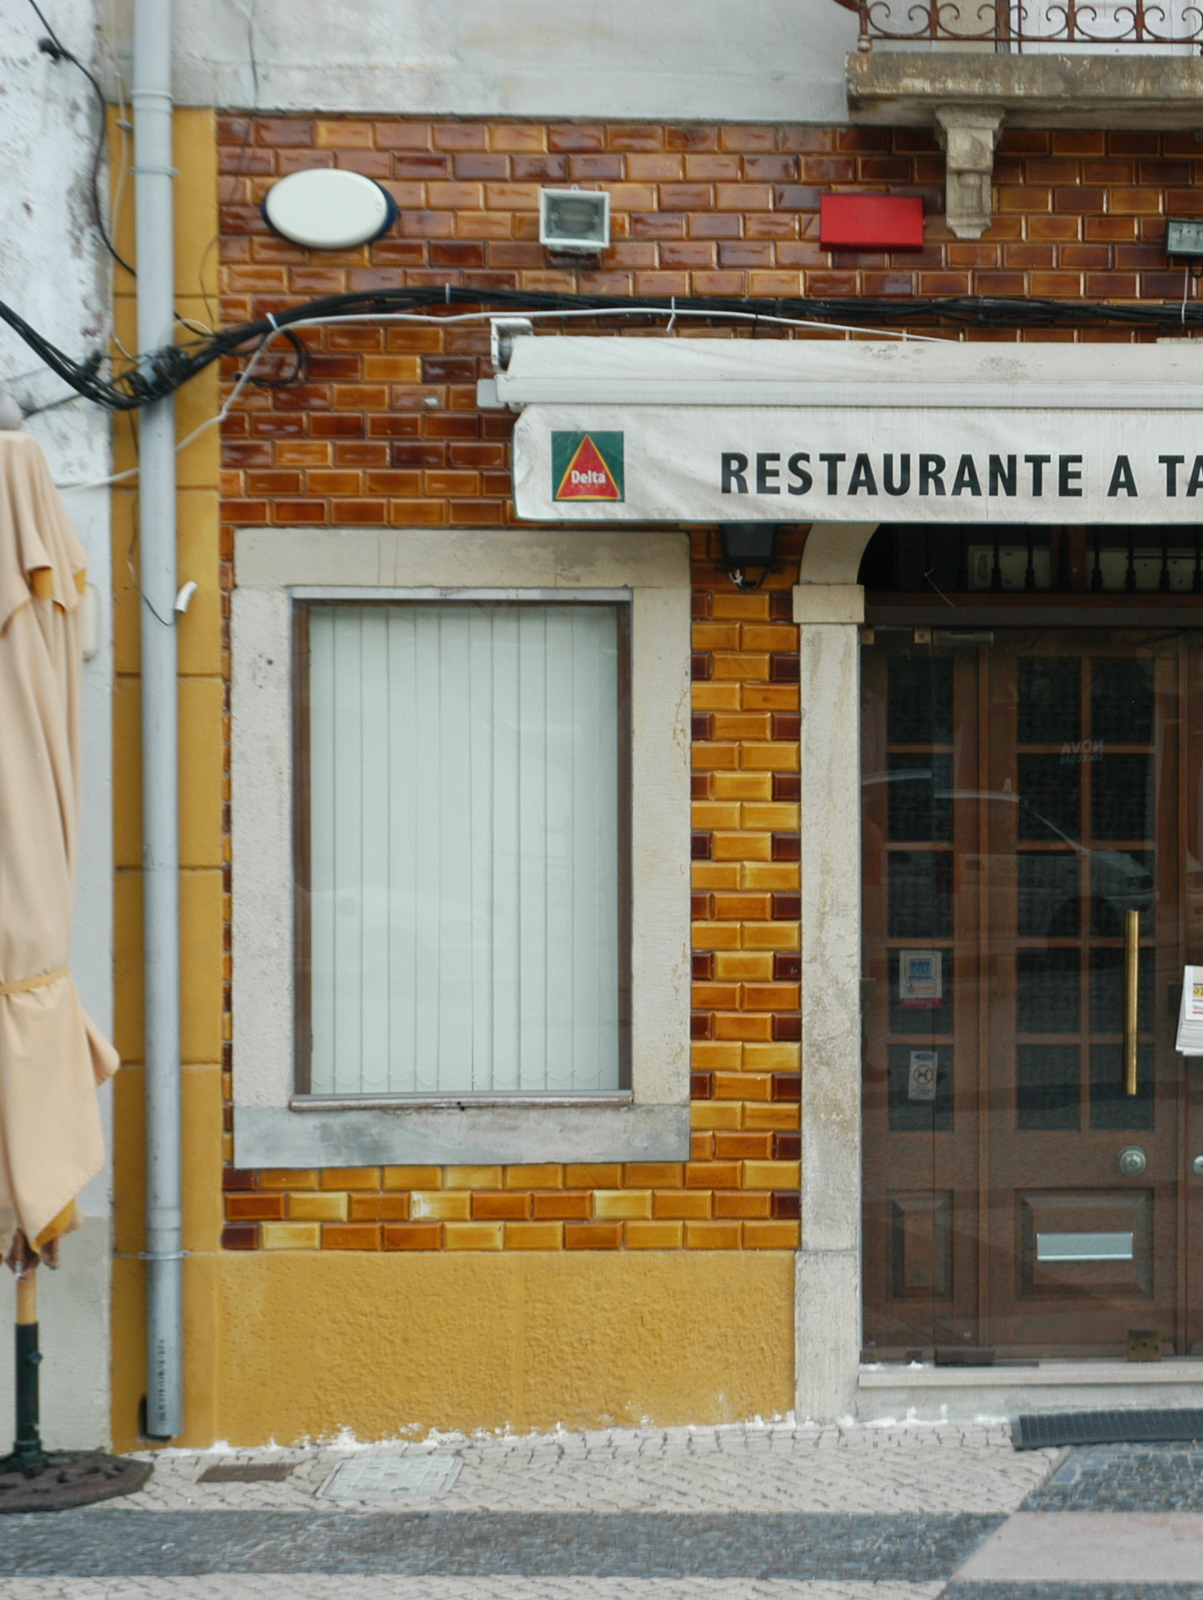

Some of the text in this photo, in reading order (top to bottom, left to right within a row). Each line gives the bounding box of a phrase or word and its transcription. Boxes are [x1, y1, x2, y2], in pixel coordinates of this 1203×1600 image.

[571, 470, 606, 484] Delta
[722, 453, 1082, 496] RESTAURANTE
[1108, 456, 1138, 496] A
